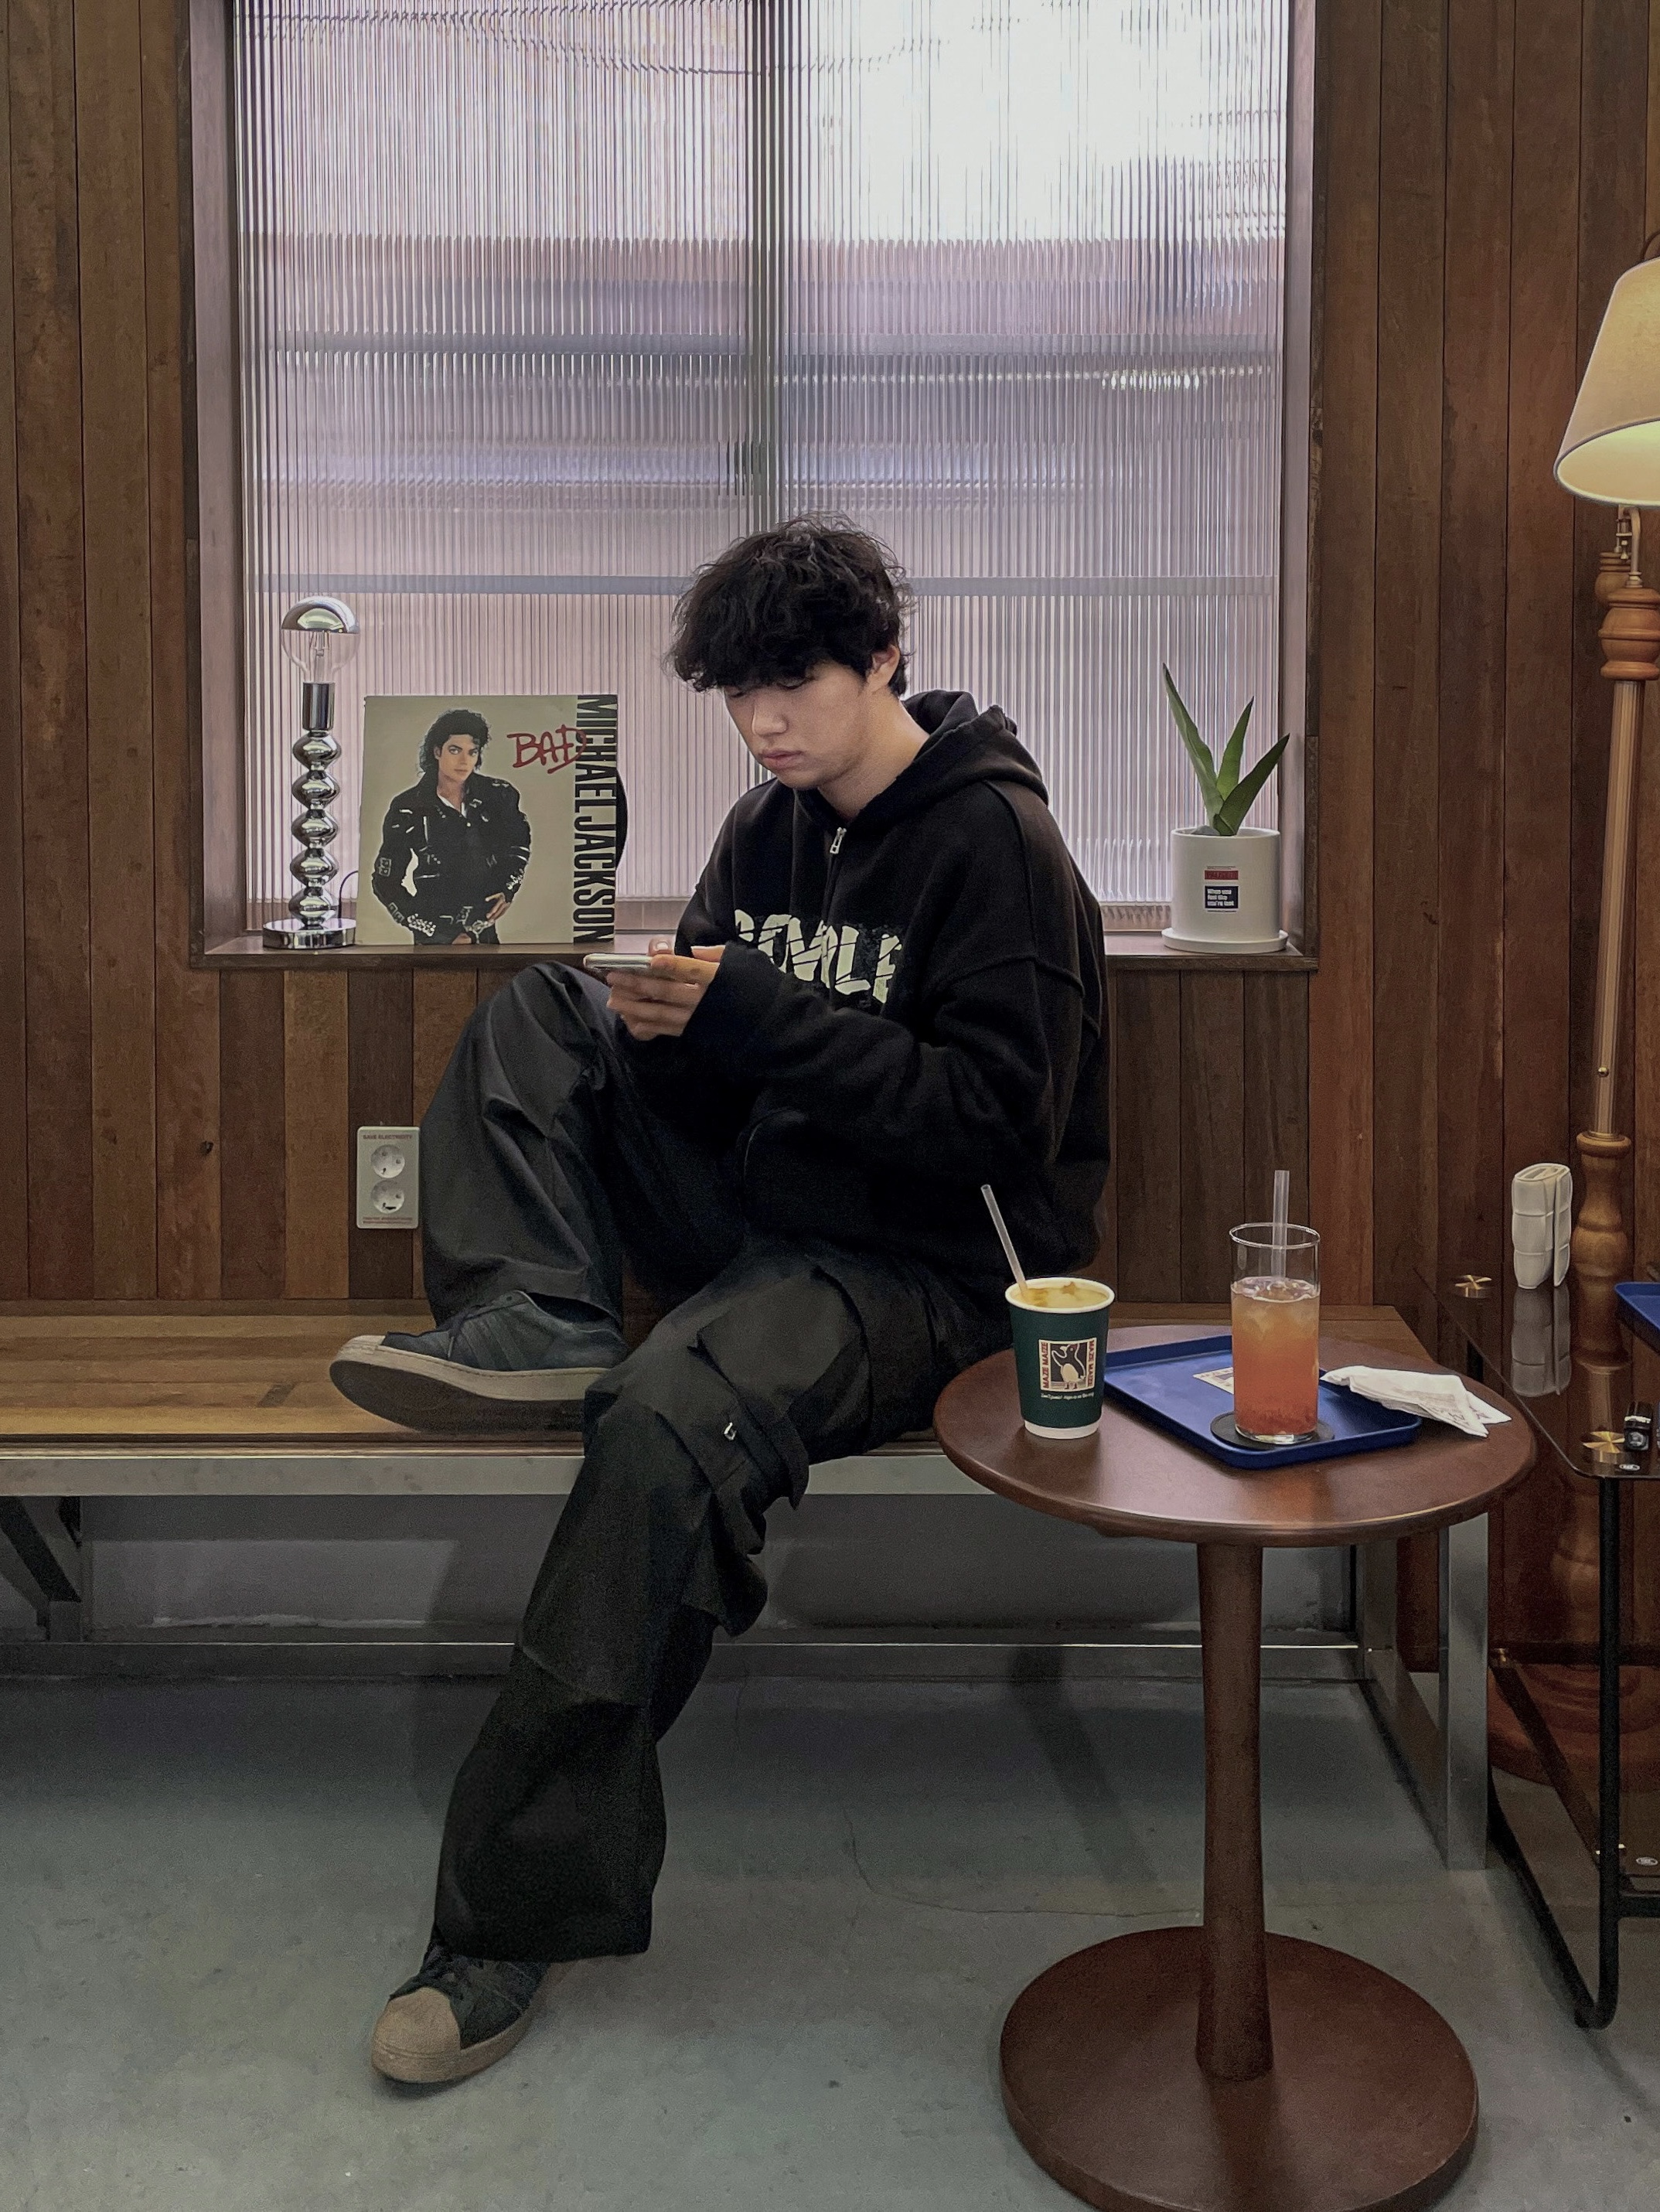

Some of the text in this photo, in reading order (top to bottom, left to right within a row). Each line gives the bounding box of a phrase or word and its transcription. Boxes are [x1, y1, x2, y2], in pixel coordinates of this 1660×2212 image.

[506, 724, 587, 774] BAD
[573, 694, 618, 943] MICHAEL JACKSON
